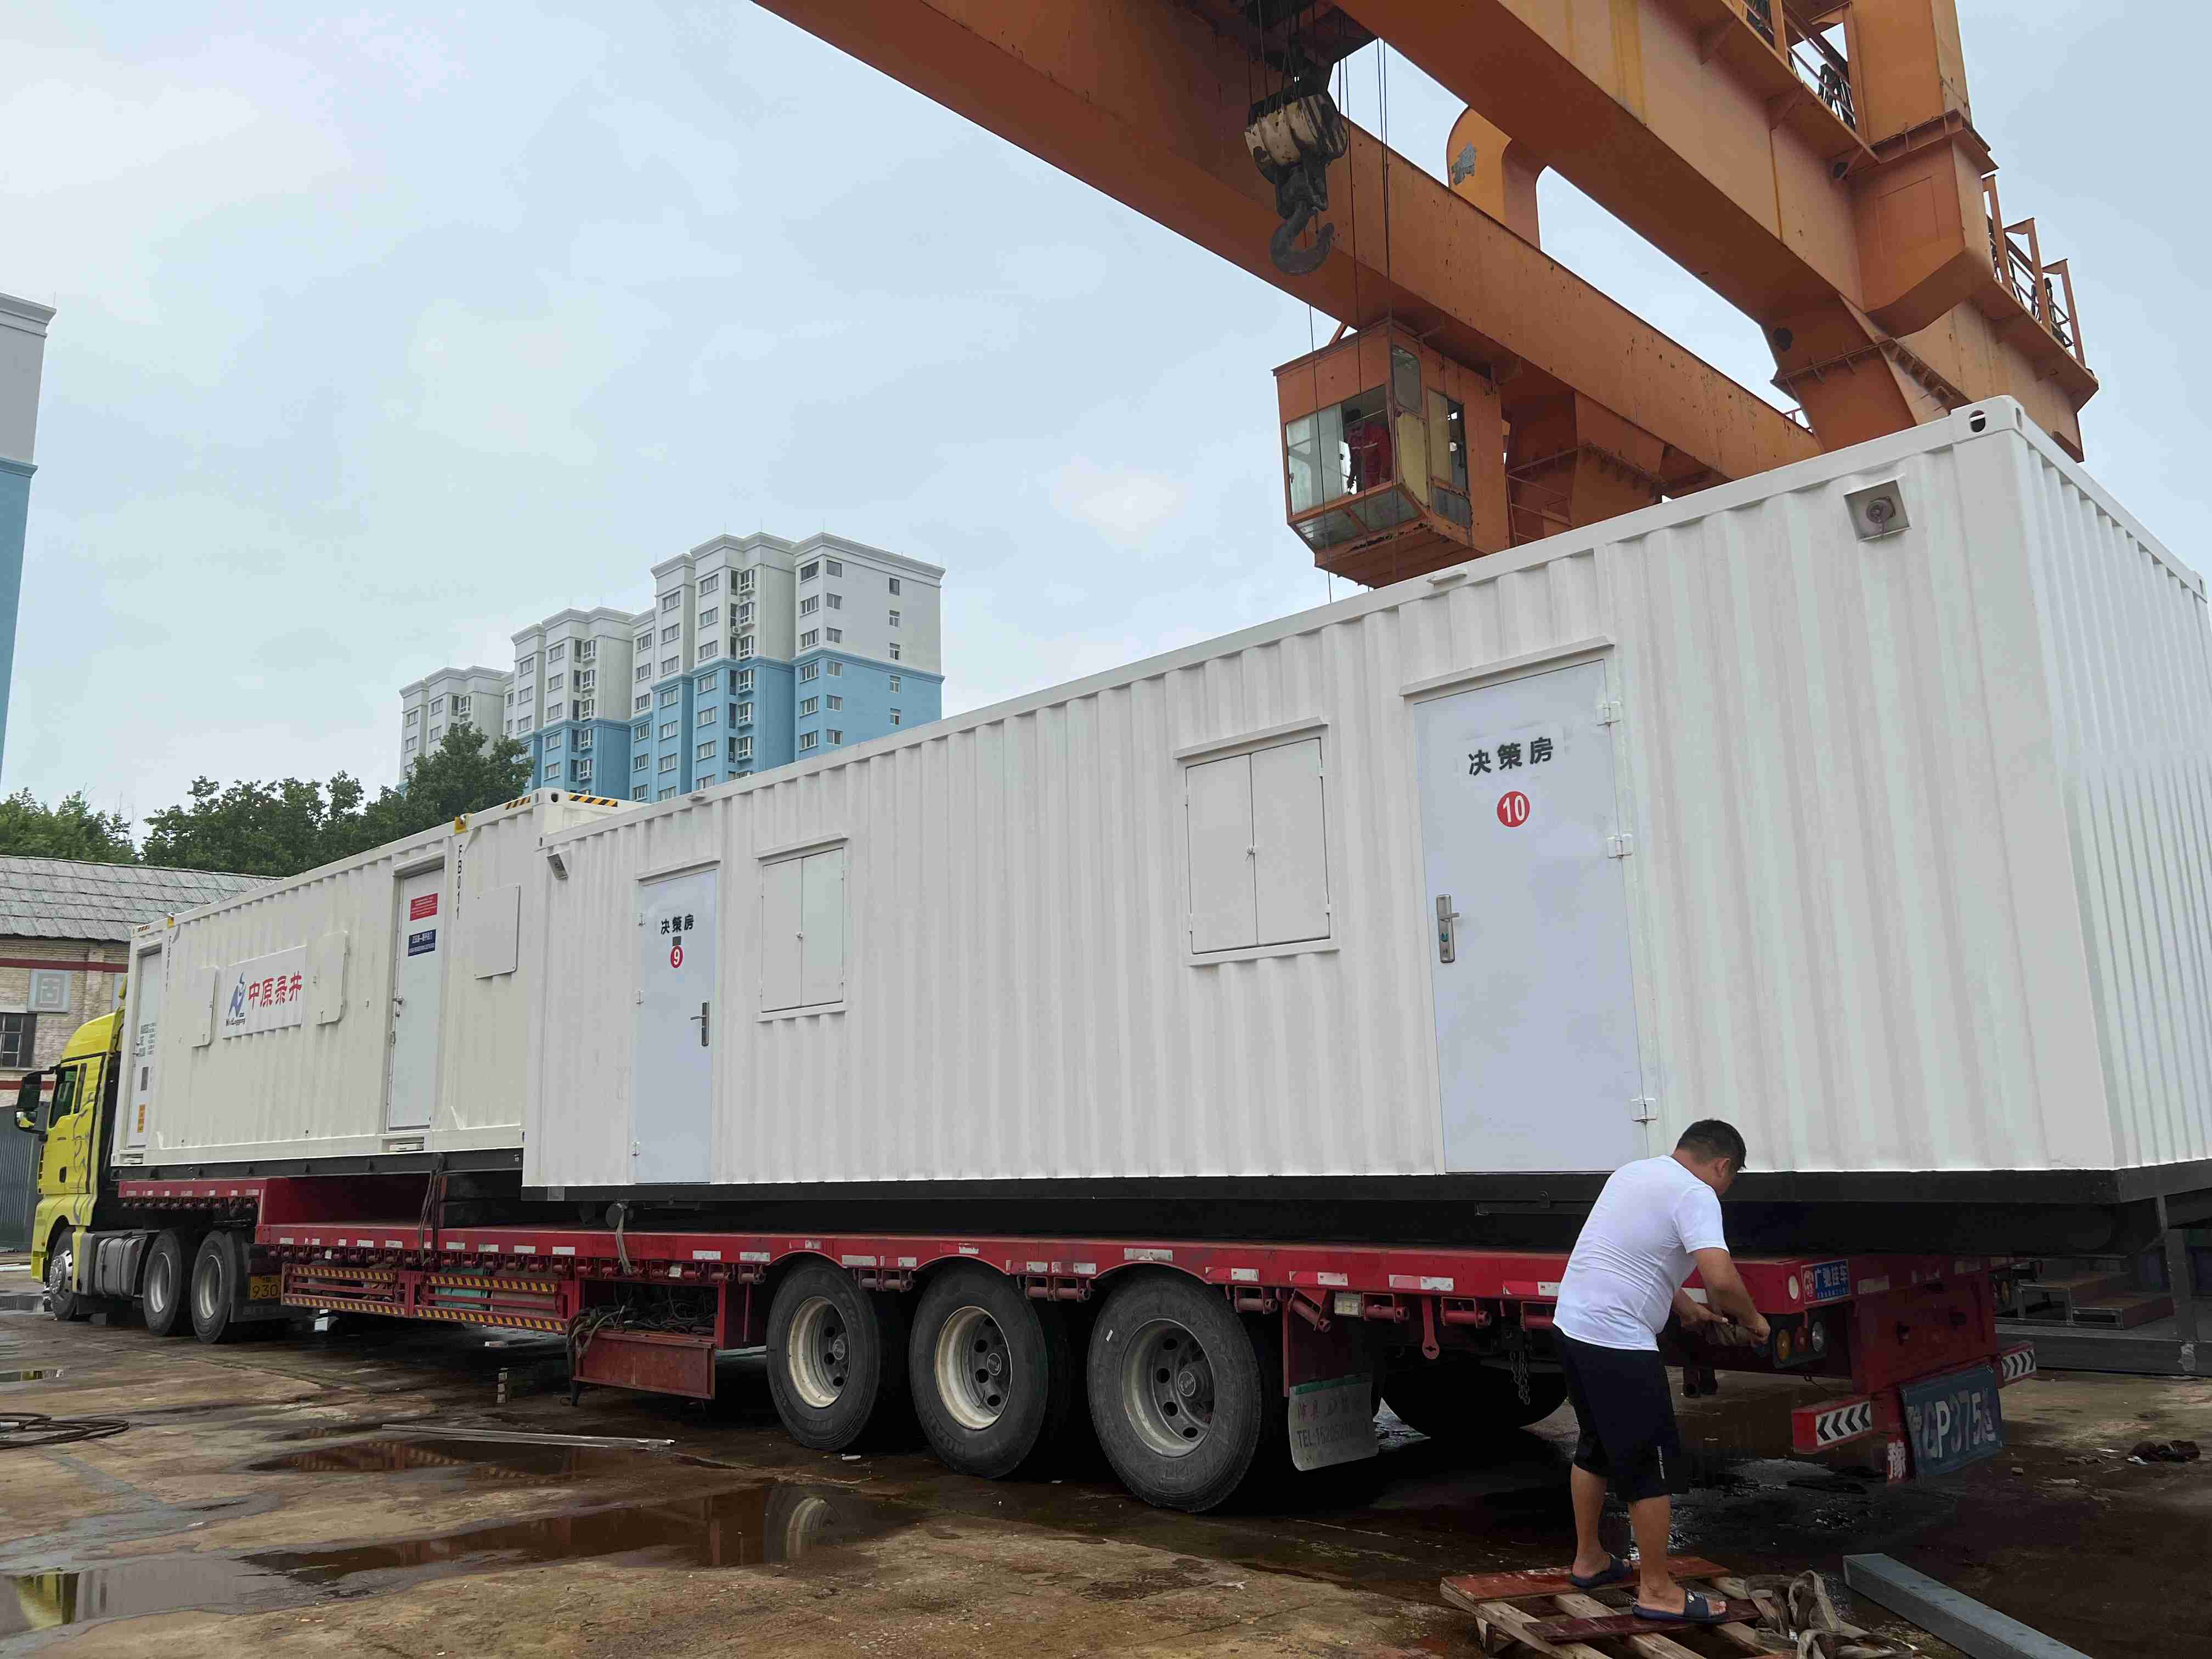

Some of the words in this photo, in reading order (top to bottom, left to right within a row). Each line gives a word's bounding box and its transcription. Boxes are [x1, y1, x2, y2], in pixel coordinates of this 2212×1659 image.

[1468, 736, 1554, 776] 决策房
[1502, 795, 1526, 823] 10
[661, 913, 695, 935] 决策房
[673, 949, 681, 966] 9
[248, 970, 303, 1010] 中原录井
[252, 1283, 281, 1299] 930
